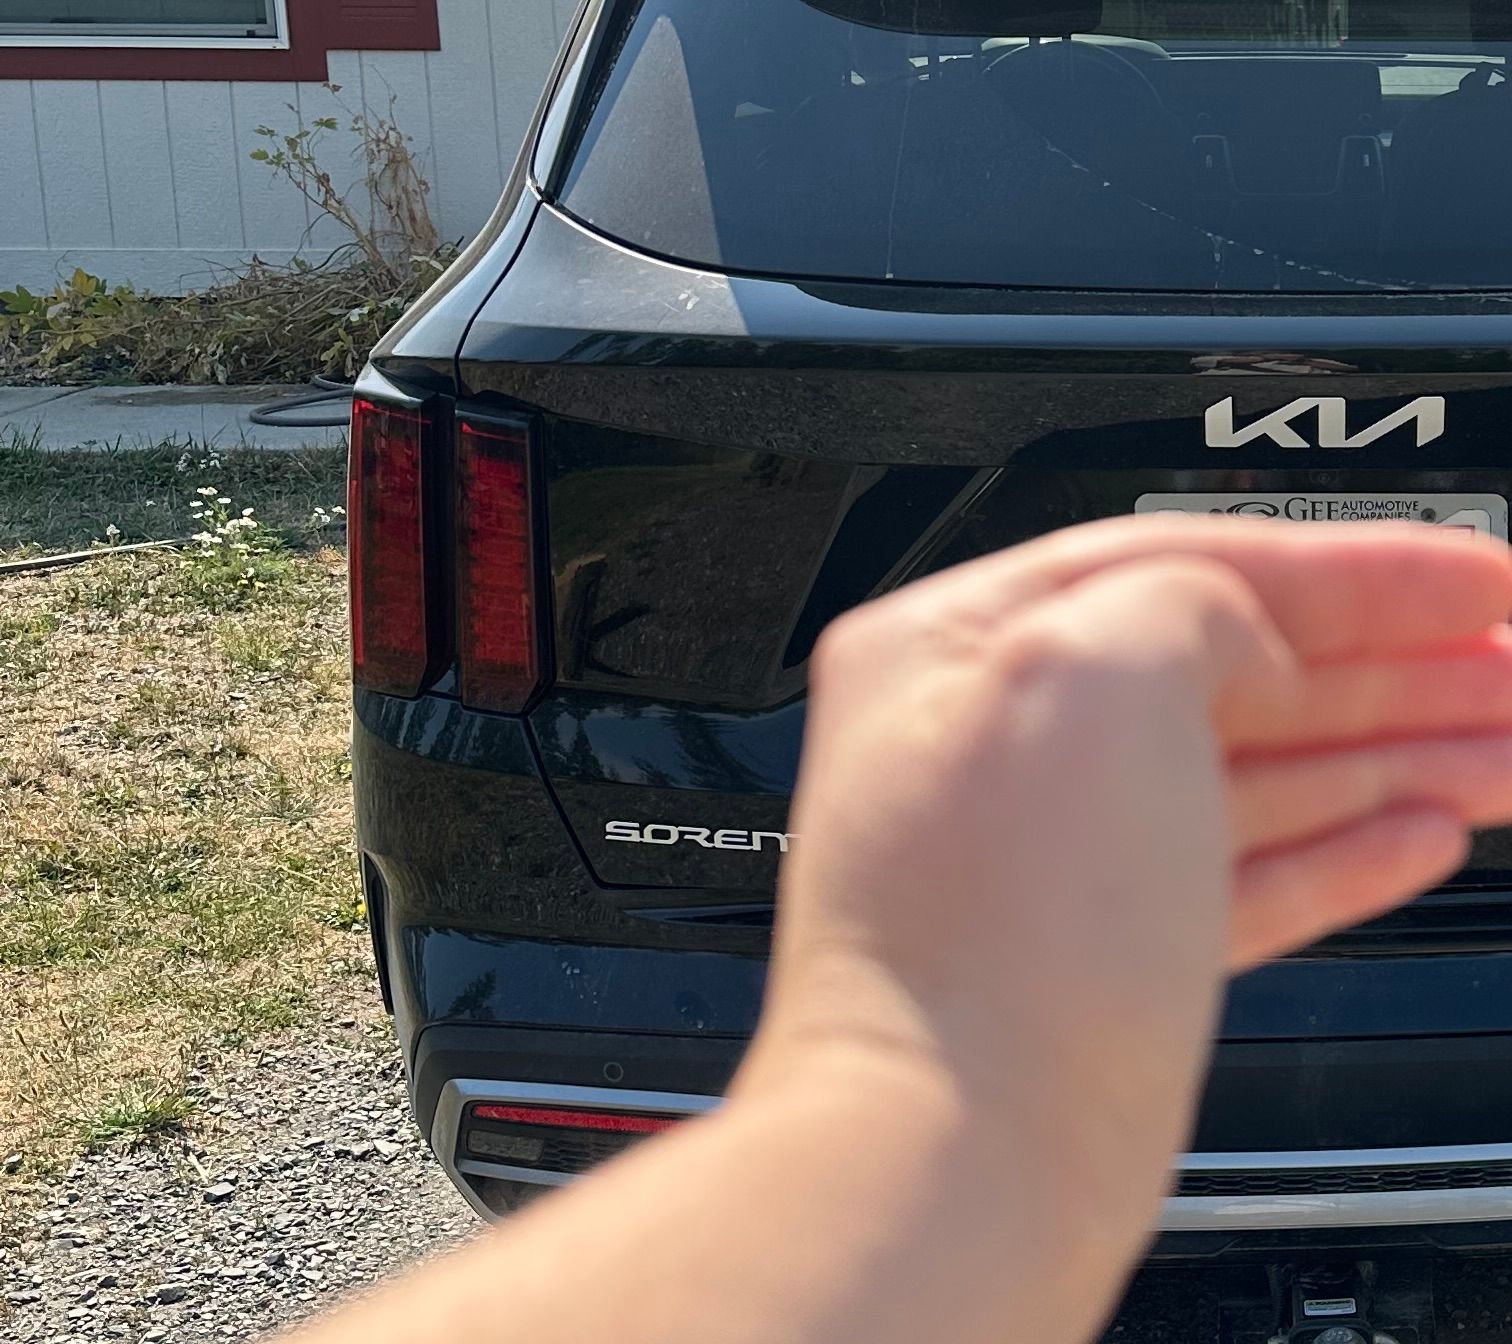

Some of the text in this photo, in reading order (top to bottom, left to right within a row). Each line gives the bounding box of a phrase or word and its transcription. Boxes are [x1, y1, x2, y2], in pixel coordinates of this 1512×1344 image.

[1205, 396, 1446, 449] KIA
[1284, 497, 1419, 522] GEE AUTOMOTIVE
[1341, 511, 1411, 522] COMPANIES
[605, 820, 800, 853] SOREN
